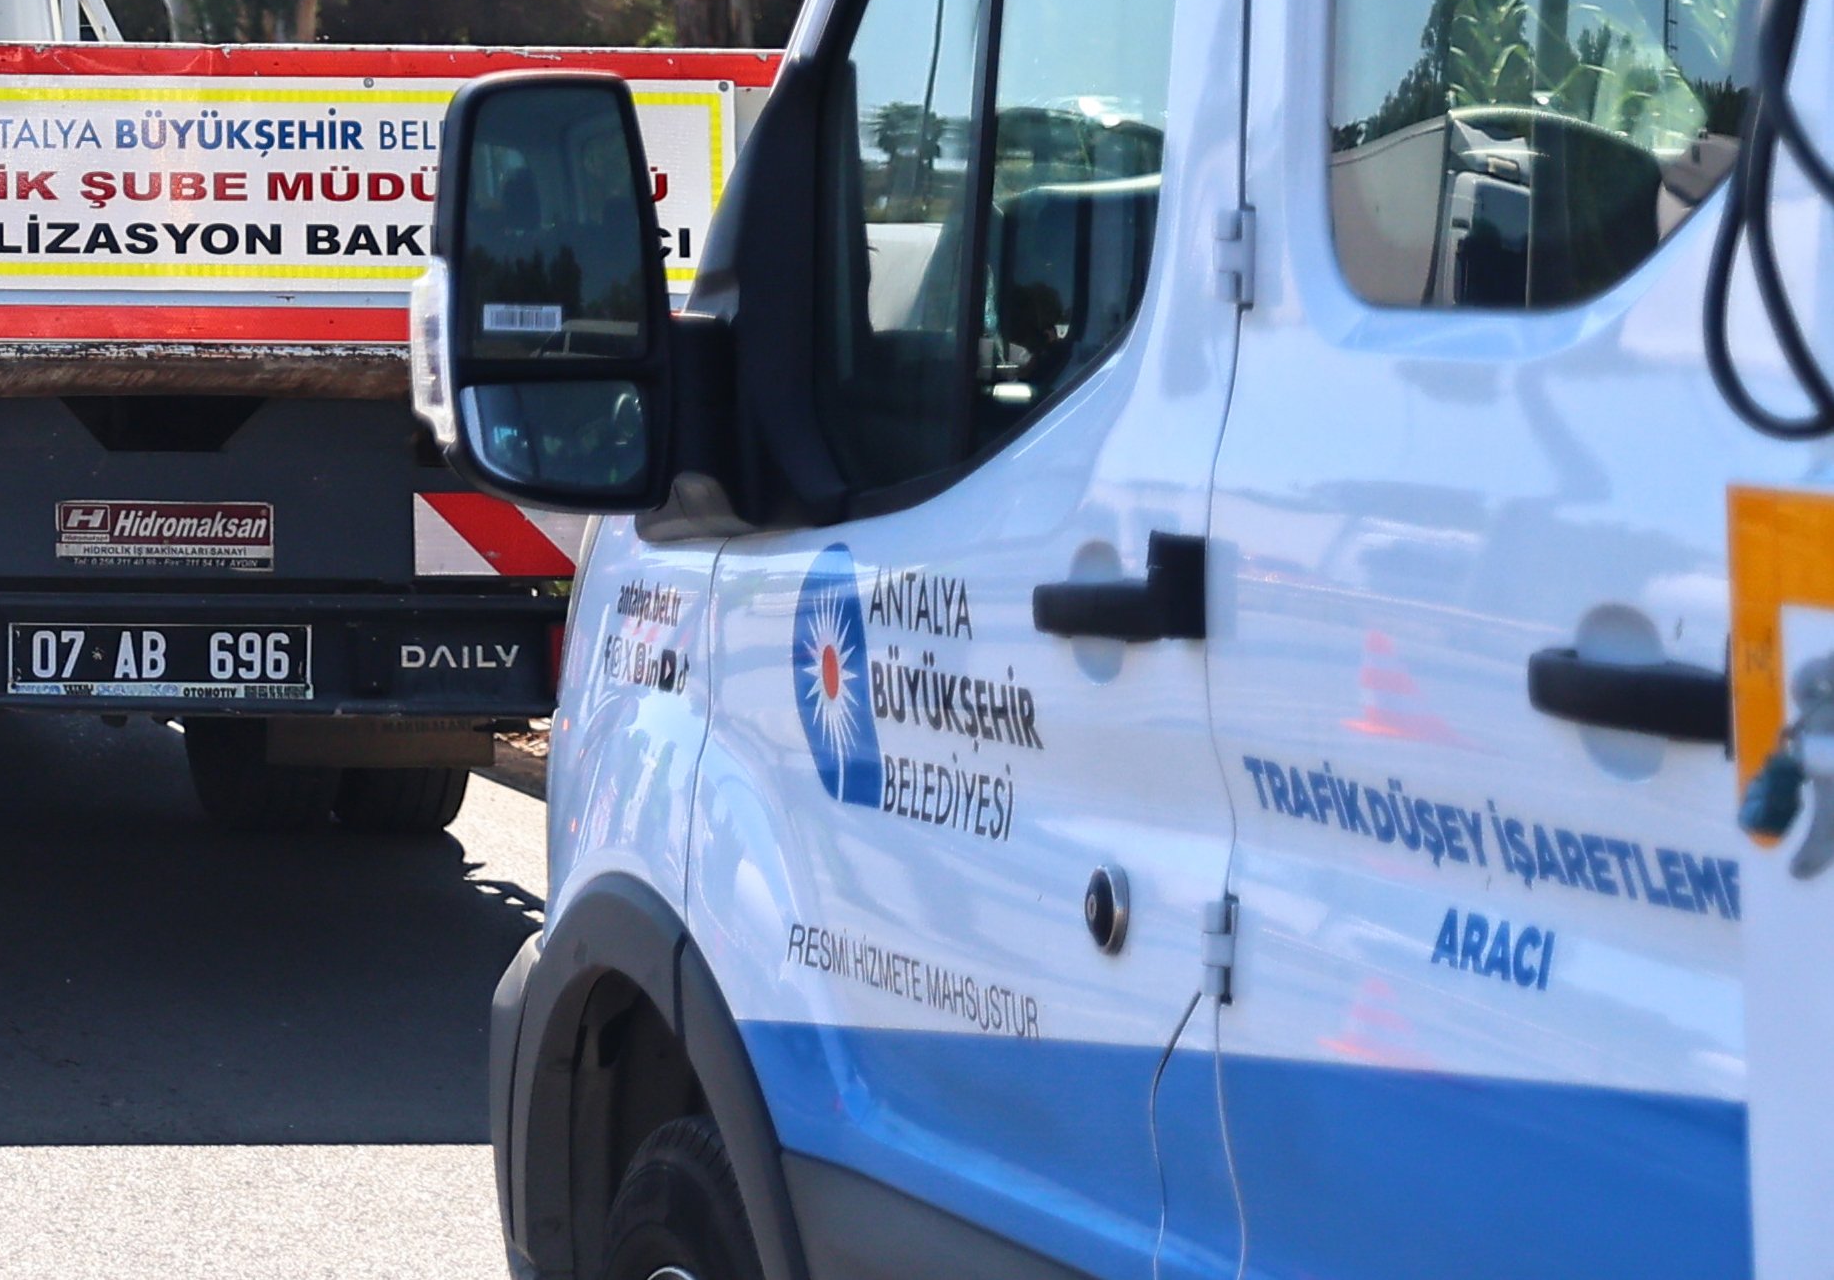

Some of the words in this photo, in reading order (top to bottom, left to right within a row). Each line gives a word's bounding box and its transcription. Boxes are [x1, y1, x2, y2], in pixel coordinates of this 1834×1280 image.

[115, 107, 365, 158] BÜYÜKŞEHİR
[81, 170, 248, 209] ŞUBE
[113, 508, 267, 540] Hidromaksan
[83, 545, 131, 555] HİDROLİK
[145, 545, 208, 556] MAKİNALARI
[210, 546, 247, 556] SANAYİ
[617, 578, 681, 628] antalya.bel.tr
[869, 565, 973, 640] ANTALYA
[32, 630, 85, 678] 07
[114, 631, 167, 679] AB
[209, 632, 290, 680] 696
[400, 644, 520, 669] DAILY
[871, 644, 1044, 753] BÜYÜKŞEHİR
[883, 752, 1014, 842] BELEDİYESİ
[1243, 755, 1365, 836] TRAFİK
[1363, 777, 1488, 869] DÜŞEY
[1432, 908, 1555, 991] ARACI
[787, 924, 850, 978] RESMİ
[852, 934, 923, 1003] HİZMETE
[925, 964, 1039, 1041] MAHSUSTUR
